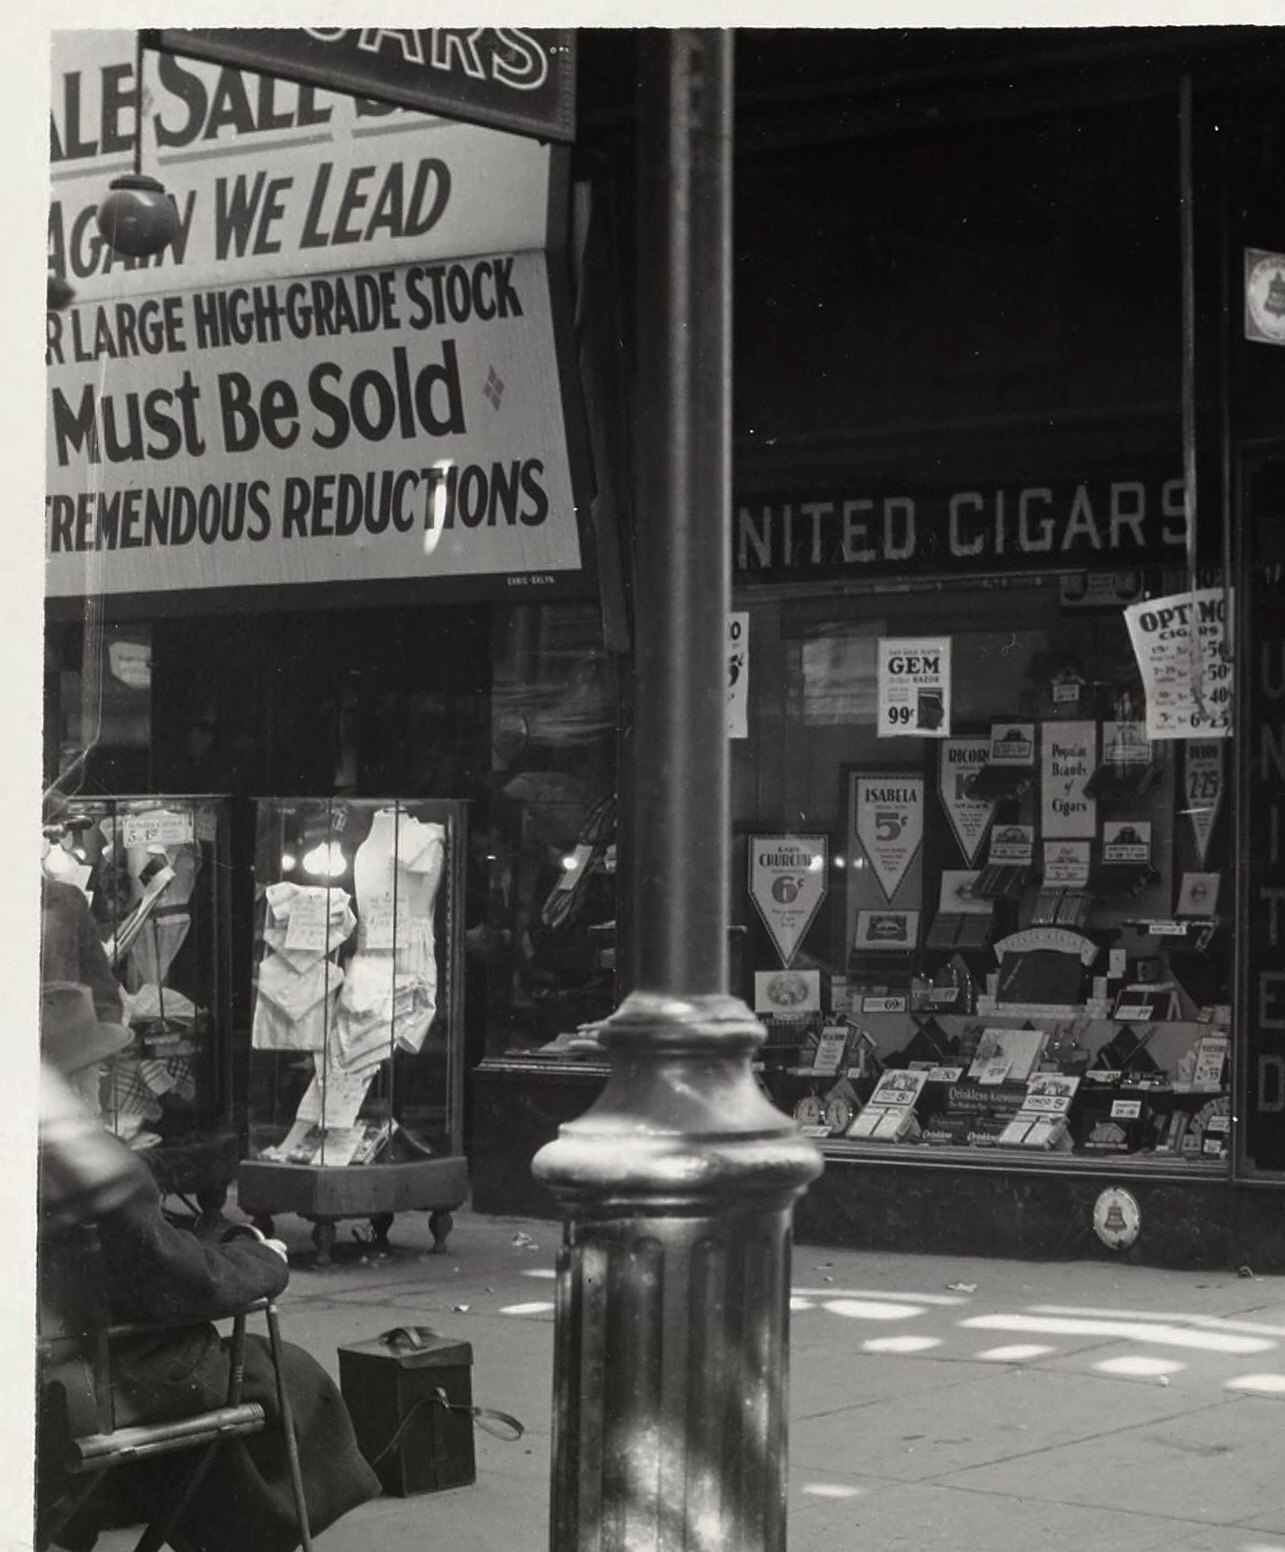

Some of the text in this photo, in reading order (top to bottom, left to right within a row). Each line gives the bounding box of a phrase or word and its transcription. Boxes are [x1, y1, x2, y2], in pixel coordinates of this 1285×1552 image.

[215, 171, 293, 260] WE
[300, 157, 451, 246] LEAD
[71, 299, 186, 362] LARGE
[193, 271, 399, 350] HIGH-GRADE
[405, 257, 524, 331] STOCK
[53, 339, 466, 467] Must Be Sold
[46, 458, 549, 553] TREMENDOUS REDUCTIONS
[949, 479, 1191, 557] CIGARS
[888, 657, 940, 675] GEM
[1158, 626, 1218, 640] CIGRS
[1052, 799, 1088, 817] Cigars
